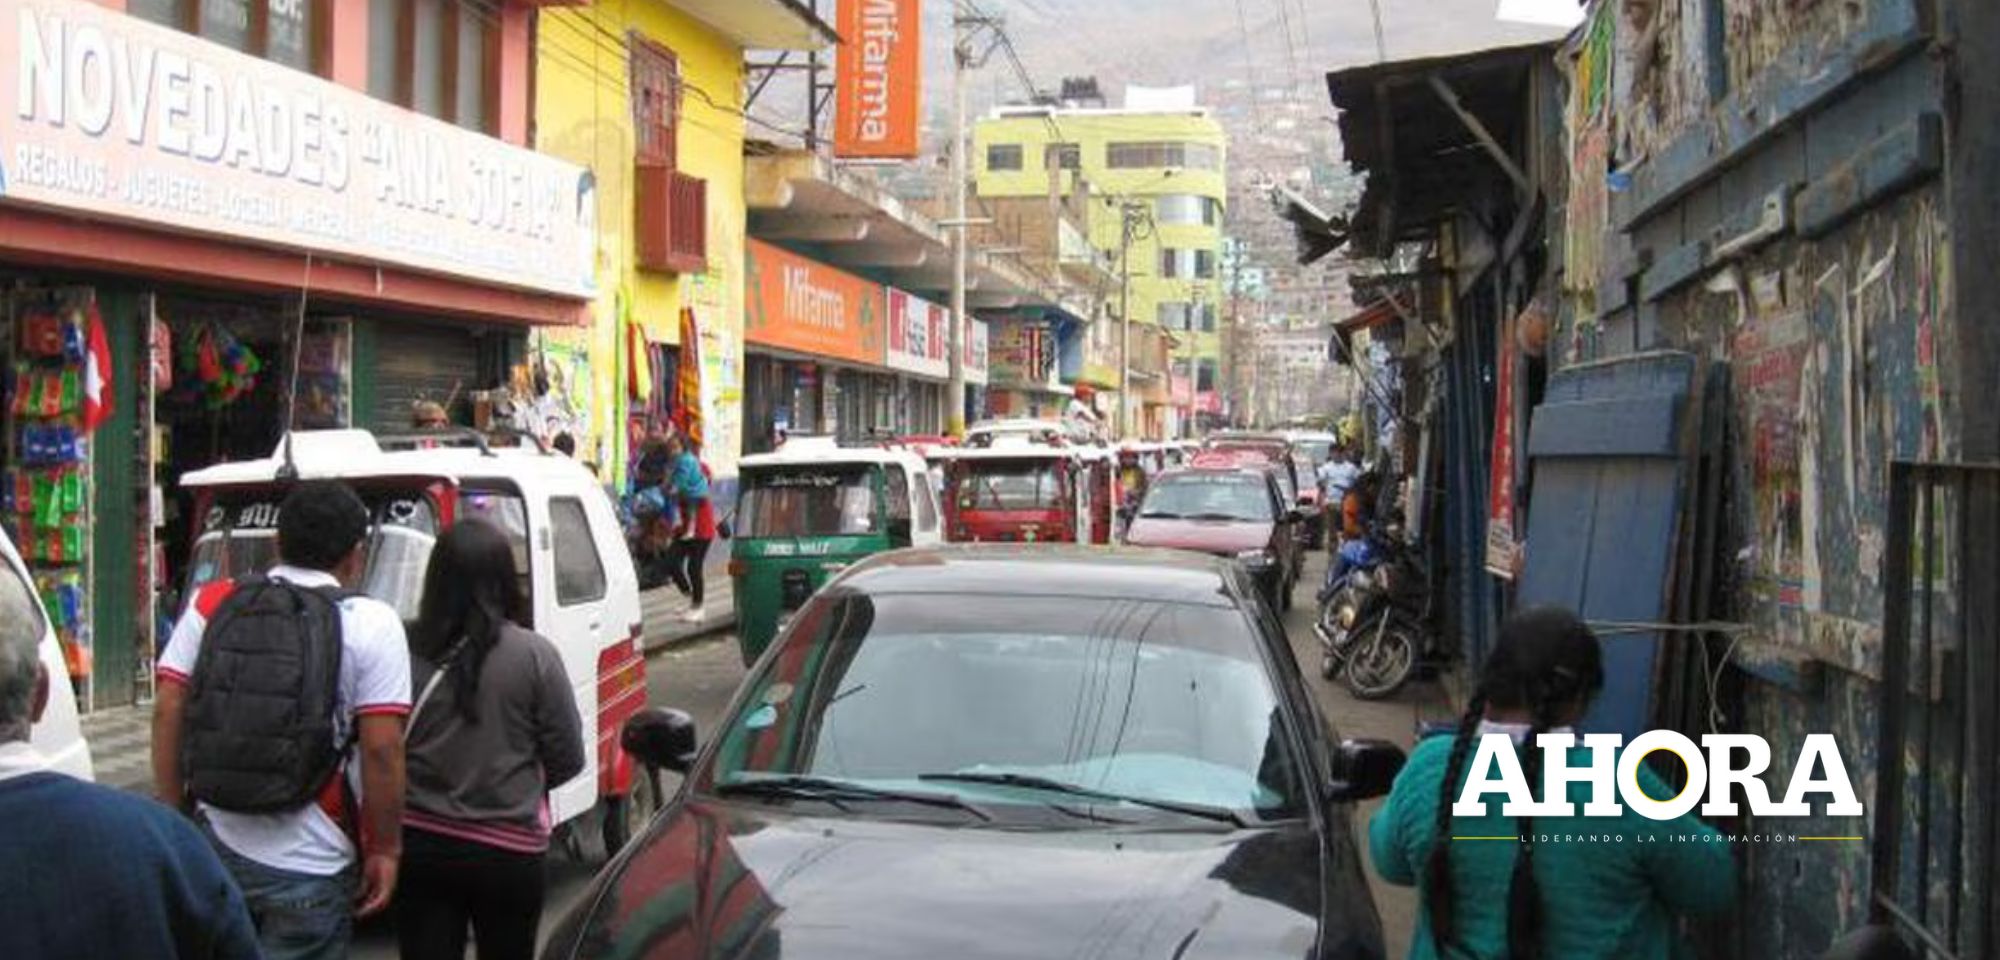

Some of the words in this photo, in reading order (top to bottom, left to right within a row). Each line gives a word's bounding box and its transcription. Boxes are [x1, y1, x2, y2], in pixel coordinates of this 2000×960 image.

[18, 9, 351, 193] NOVEDADES
[15, 141, 109, 200] REGALOS
[783, 264, 846, 332] Mifarma
